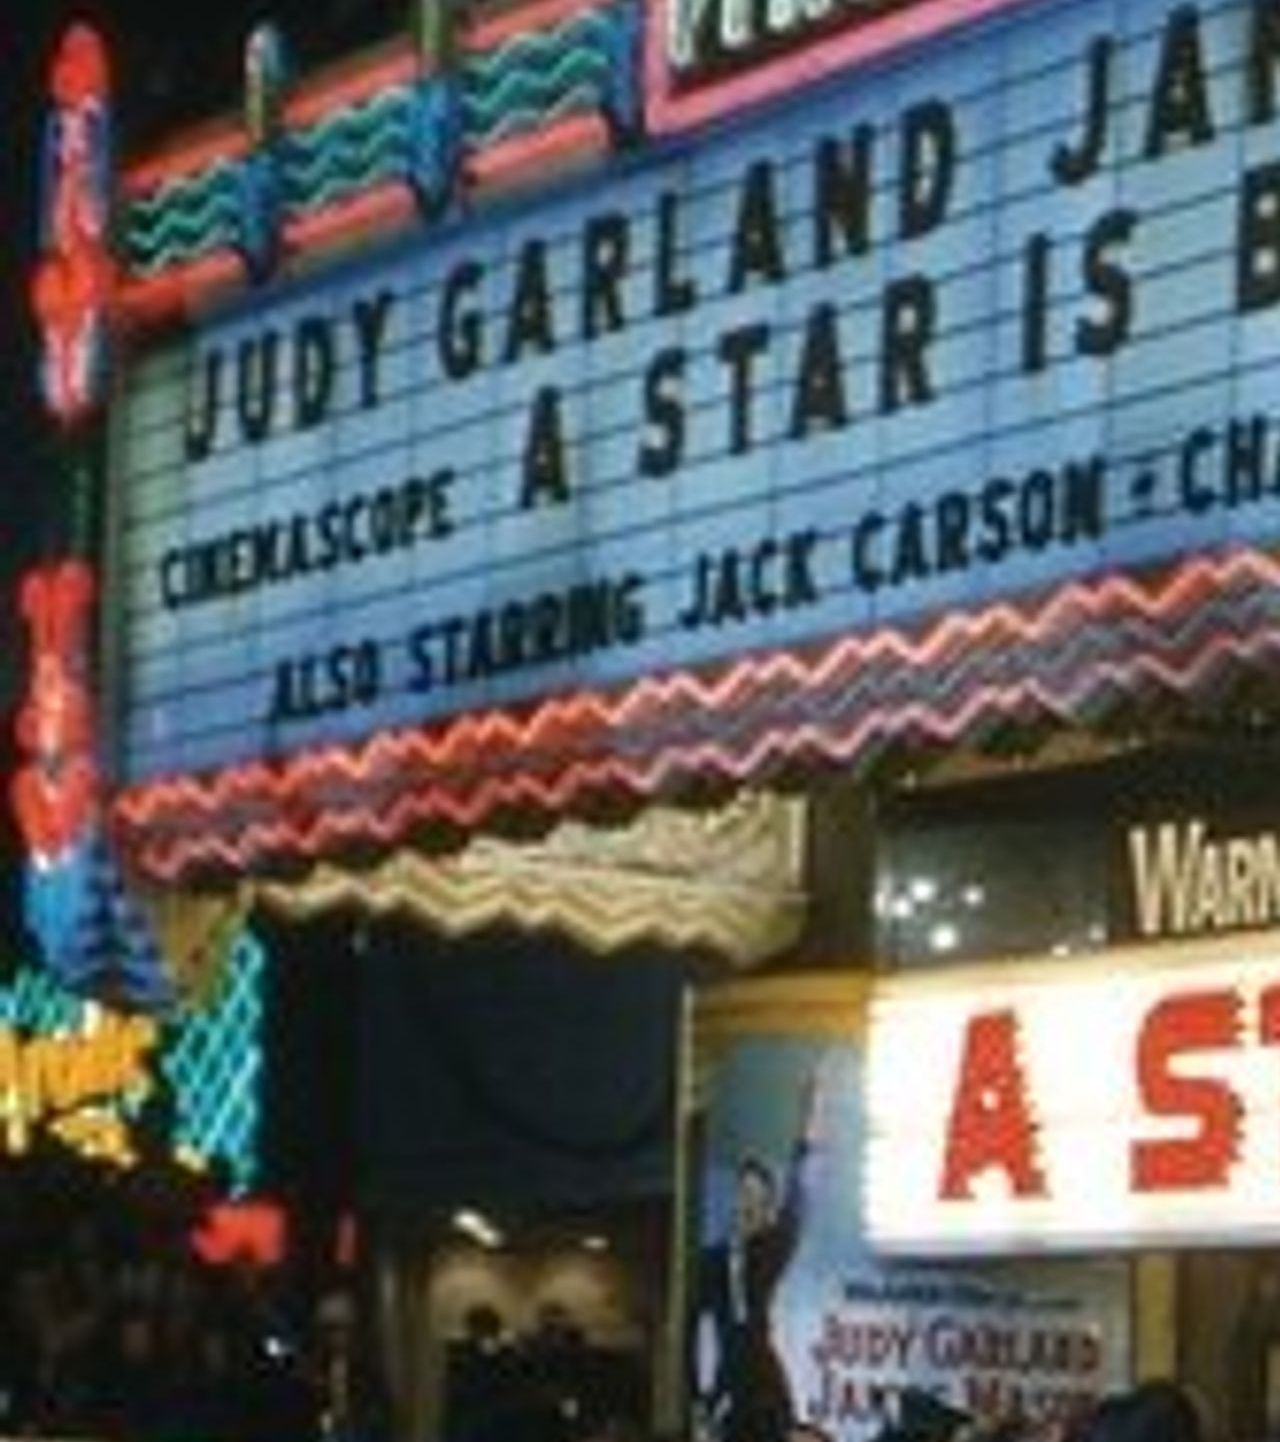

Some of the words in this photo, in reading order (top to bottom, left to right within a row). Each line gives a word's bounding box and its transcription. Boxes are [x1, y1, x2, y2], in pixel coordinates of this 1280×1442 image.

[180, 288, 393, 463] JUDY
[436, 100, 955, 381] GARLAND
[520, 385, 573, 510] A
[637, 272, 936, 478] STAR
[1022, 208, 1139, 372] IS
[159, 469, 457, 612] CINEMASCOPE
[270, 639, 383, 724] ALSO
[408, 575, 647, 694] STARRING
[678, 528, 819, 631] JACK
[851, 452, 1109, 593] CARSON
[937, 1009, 1051, 1201] A
